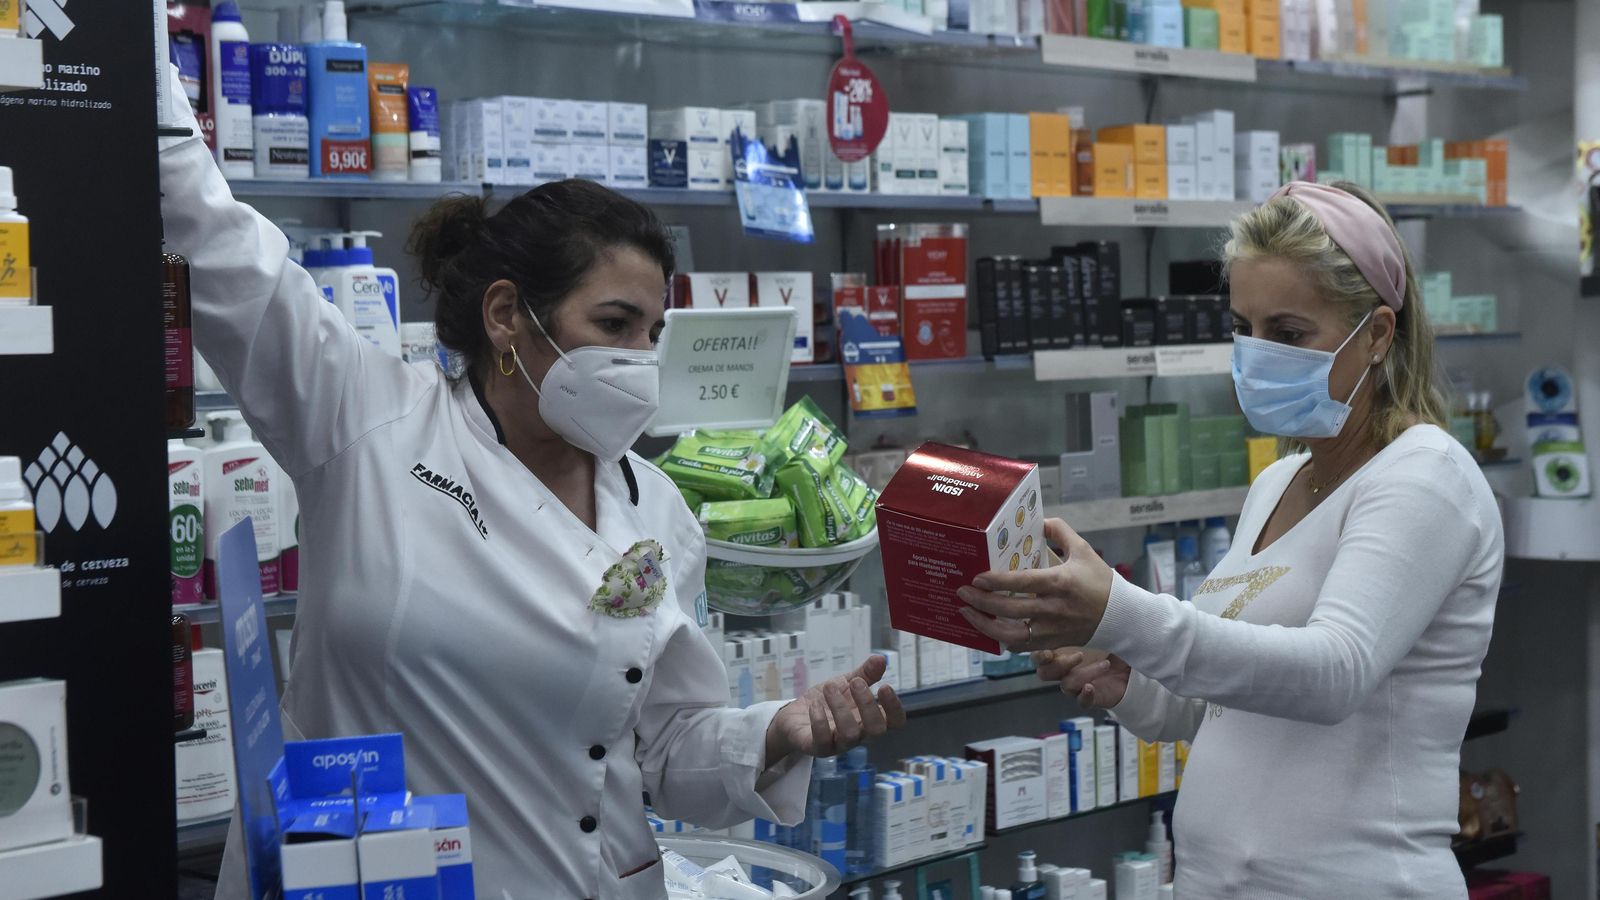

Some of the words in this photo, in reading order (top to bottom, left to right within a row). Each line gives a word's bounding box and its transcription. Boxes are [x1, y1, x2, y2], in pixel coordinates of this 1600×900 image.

[58, 63, 100, 76] marino
[329, 151, 368, 170] 9,90€
[352, 279, 393, 294] CeraVe
[693, 335, 758, 352] OFERTA!!
[688, 364, 714, 374] CREMA
[715, 363, 725, 373] DE
[726, 363, 754, 372] MANOS
[699, 385, 728, 400] 2.50
[731, 384, 740, 399] €
[234, 478, 269, 493] sebamed
[412, 462, 478, 521] FARMACIA
[931, 482, 964, 497] ISDIN
[732, 528, 777, 544] vivitas
[61, 560, 76, 572] de
[81, 557, 130, 571] cerveza
[76, 576, 109, 587] cerveza
